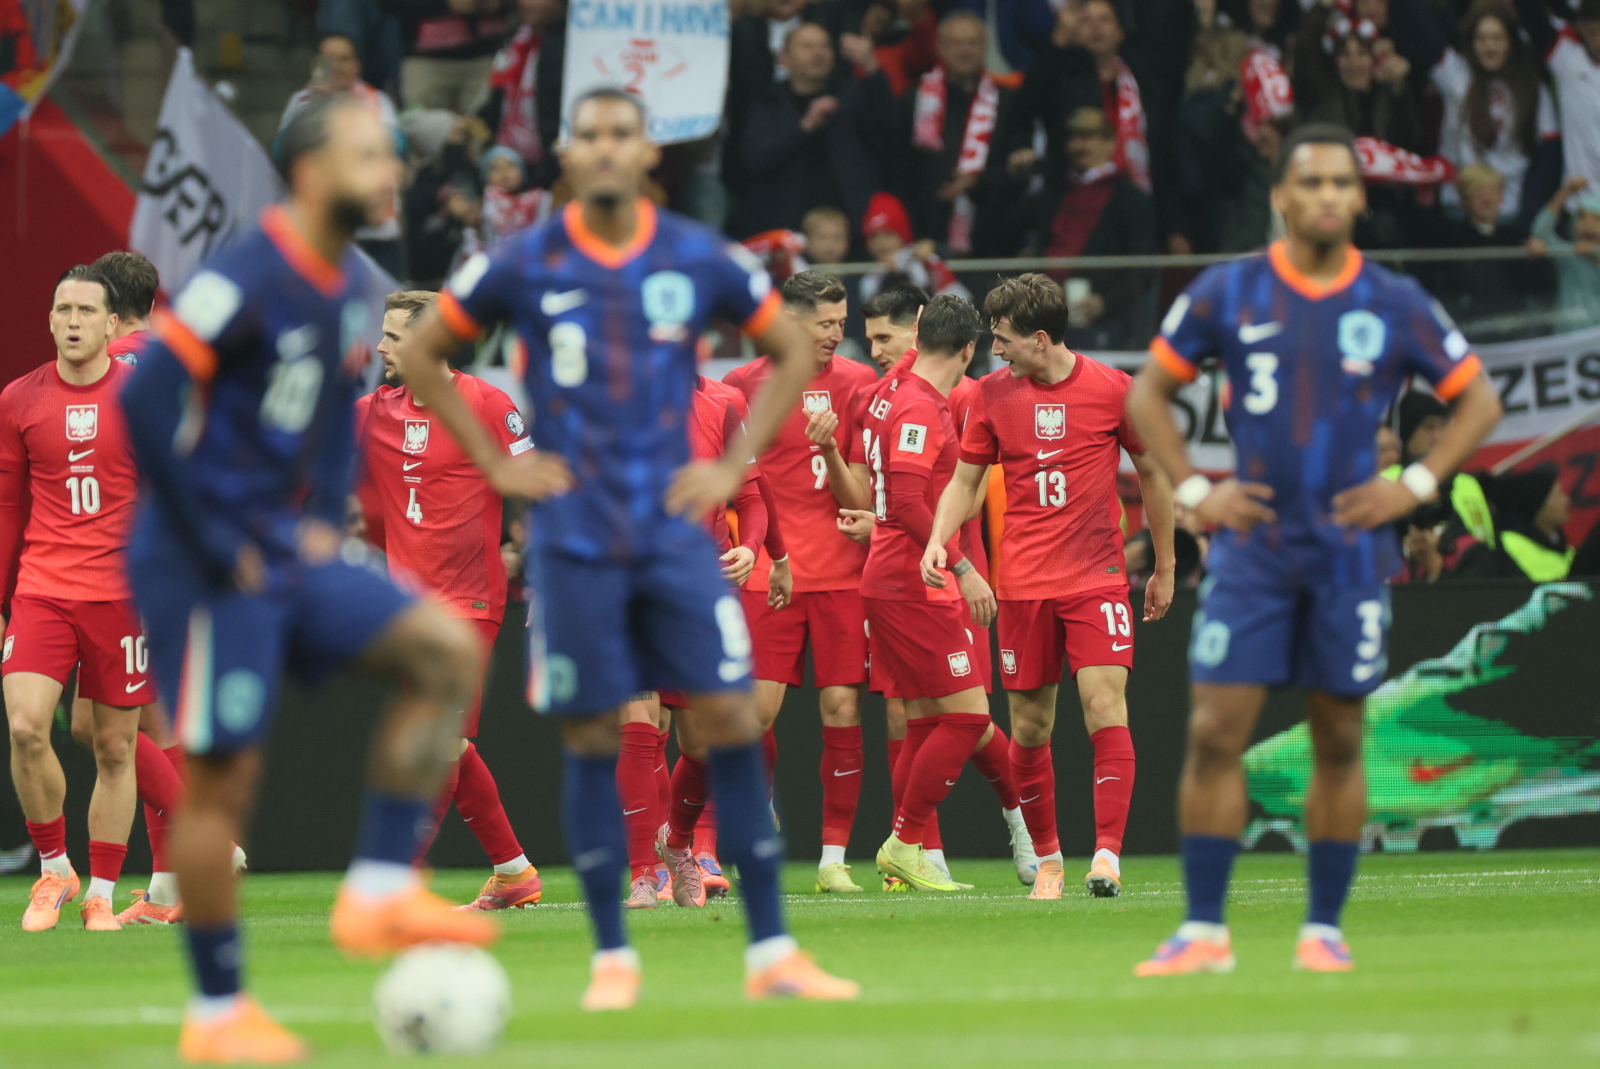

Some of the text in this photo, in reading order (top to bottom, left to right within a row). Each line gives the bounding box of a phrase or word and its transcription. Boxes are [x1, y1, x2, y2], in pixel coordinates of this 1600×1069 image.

[1244, 352, 1279, 415] 3
[811, 455, 828, 489] 9
[1034, 470, 1067, 507] 13
[65, 475, 101, 515] 10
[406, 487, 423, 524] 4
[1100, 601, 1131, 638] 13
[1356, 600, 1382, 660] 3
[120, 634, 149, 675] 10
